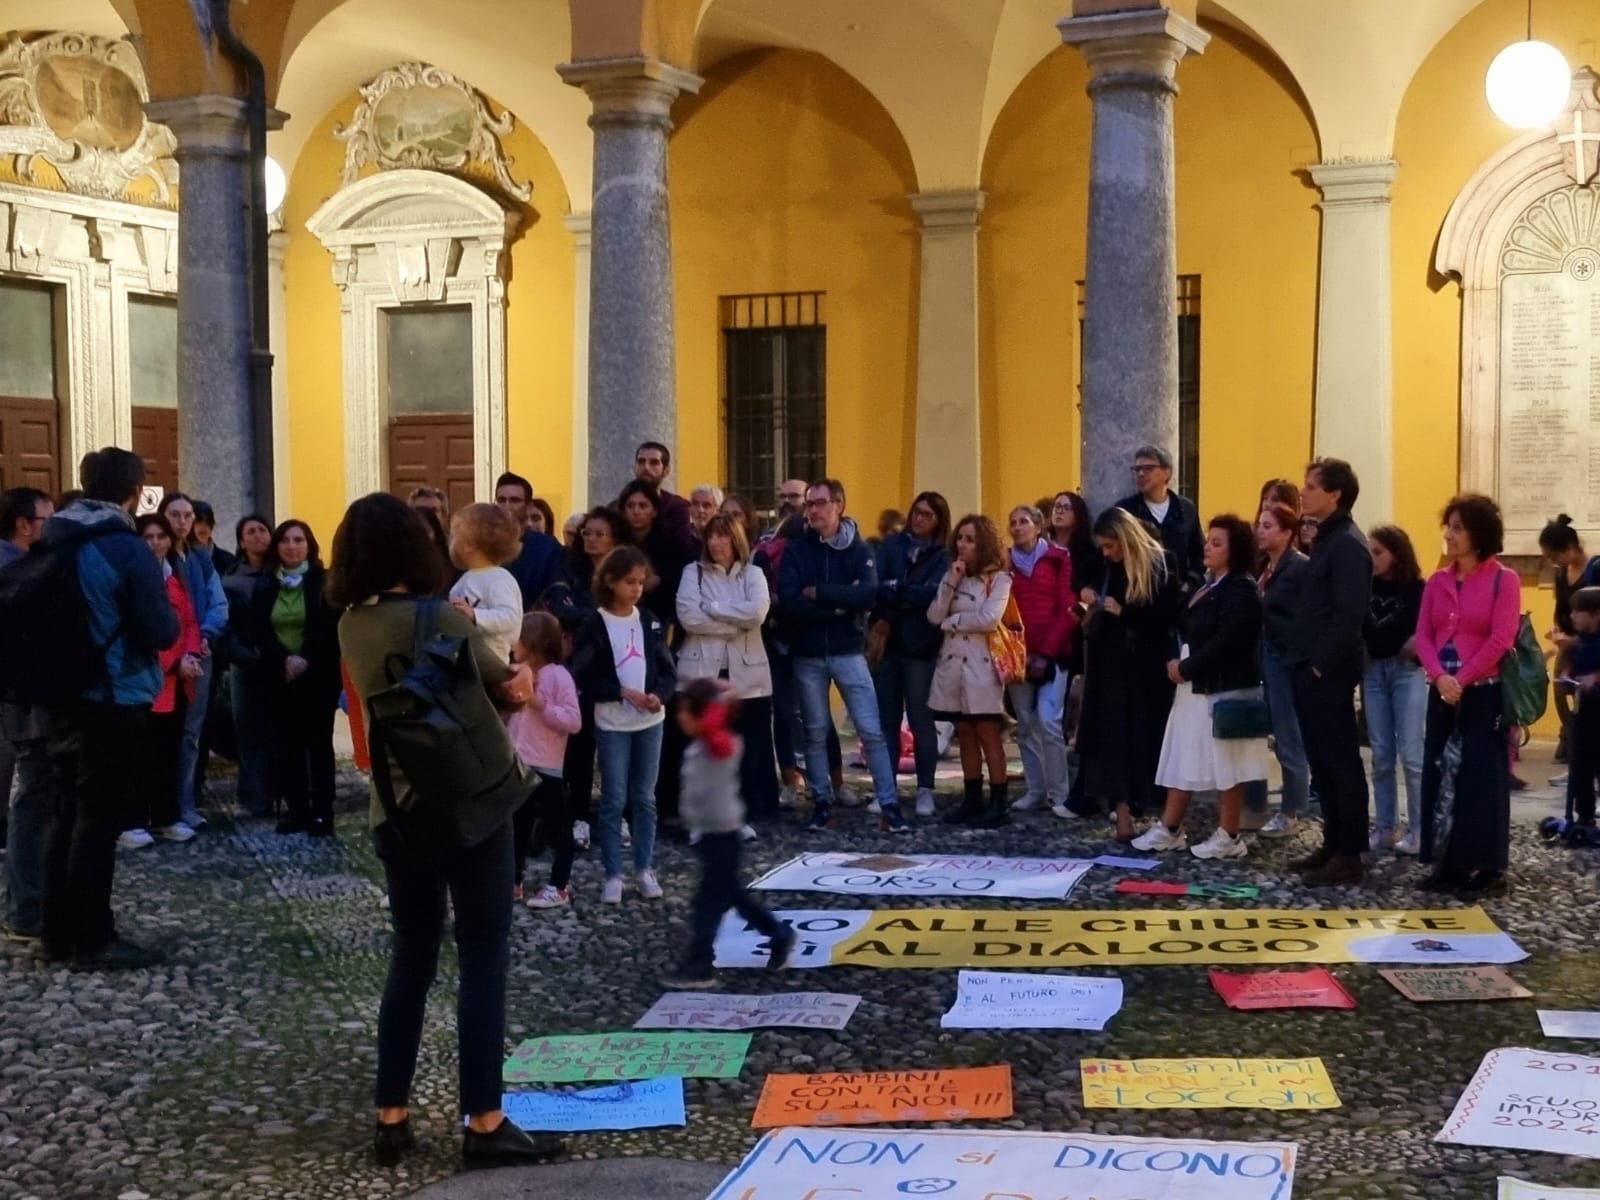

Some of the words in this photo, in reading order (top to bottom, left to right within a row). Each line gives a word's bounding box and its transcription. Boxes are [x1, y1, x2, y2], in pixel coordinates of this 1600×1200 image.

[813, 873, 996, 891] CORSO
[875, 918, 1053, 932] ALLE
[1080, 917, 1466, 933] CHIUSURE
[844, 939, 941, 956] AL
[972, 938, 1320, 956] DIALOGO
[967, 976, 989, 986] NON
[981, 993, 996, 1004] AL
[1010, 988, 1058, 1001] FUTURO
[659, 1010, 842, 1027] TRAFFICO
[576, 1061, 725, 1079] TUTTI
[1102, 1074, 1200, 1088] NON
[790, 1083, 959, 1098] CONTATE
[783, 1099, 829, 1112] SU
[892, 1093, 957, 1108] NOI
[1505, 1093, 1598, 1111] SCUO
[1498, 1102, 1600, 1122] IMPOR
[1491, 1115, 1599, 1135] 2024
[773, 1137, 925, 1166] NON
[1053, 1144, 1282, 1178] DICONO
